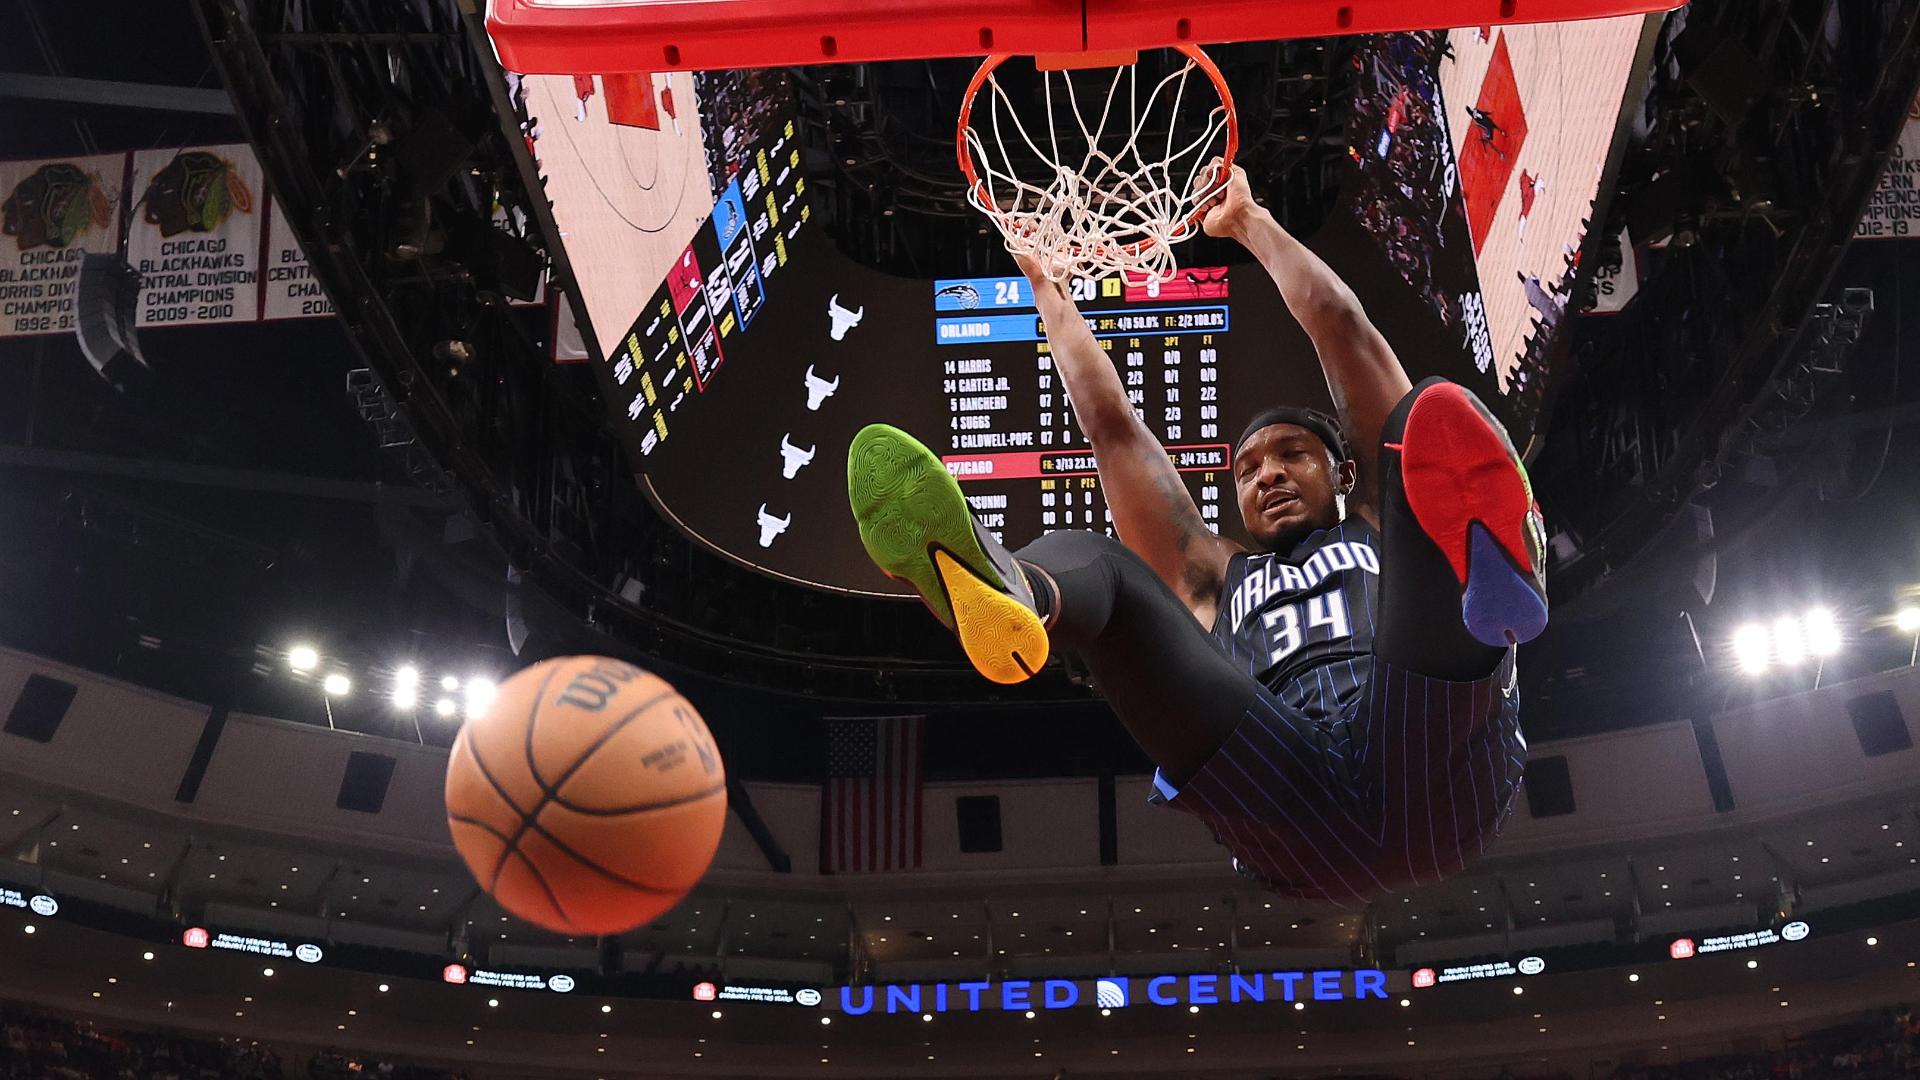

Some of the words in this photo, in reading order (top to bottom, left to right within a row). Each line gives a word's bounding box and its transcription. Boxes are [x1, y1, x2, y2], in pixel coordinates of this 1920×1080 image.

[161, 238, 227, 256] CHICAGO
[139, 253, 245, 274] BLACKHAWKS
[197, 269, 258, 286] DIVISION
[146, 287, 235, 306] CHAMPIONS
[995, 281, 1020, 305] 24
[145, 304, 234, 323] 2009-2010
[1164, 315, 1177, 327] FT:
[1177, 313, 1194, 328] 2/2
[941, 322, 991, 338] ORLANDO
[1164, 337, 1179, 347] 3PT
[1203, 335, 1213, 345] FT
[1127, 351, 1144, 366] 0/0
[1163, 350, 1181, 365] 0/0
[1200, 348, 1217, 363] 0/0
[944, 361, 956, 374] 14
[958, 359, 992, 374] HARRIS
[1039, 375, 1051, 389] 07
[1127, 370, 1144, 385] 2/3
[1164, 369, 1179, 384] 0/1
[1200, 367, 1217, 382] 0/0
[944, 379, 957, 393] 34
[958, 378, 994, 392] CARTER
[995, 377, 1011, 391] JR.
[1039, 394, 1052, 408] 07
[1166, 388, 1179, 402] 1/1
[1200, 386, 1217, 401] 2/2
[950, 398, 958, 412] 5
[959, 396, 1007, 411] BANCHERO
[1040, 412, 1052, 426] 07
[1064, 411, 1069, 425] 1
[1165, 406, 1181, 421] 2/3
[1201, 405, 1218, 420] 0/0
[951, 416, 958, 430] 4
[960, 415, 991, 430] SUGGS
[1040, 431, 1053, 445] 07
[1063, 430, 1070, 445] 0
[1167, 425, 1182, 440] 1/3
[1201, 423, 1218, 438] 0/0
[952, 435, 959, 449] 3
[961, 432, 1034, 448] CALDWELL-POPE
[1055, 458, 1074, 472] 3/13
[1180, 452, 1195, 466] 3/4
[1195, 451, 1221, 465] 75.0%
[946, 460, 993, 475] CHICAGO
[1041, 479, 1056, 490] MIN
[1065, 479, 1071, 489] F
[1080, 478, 1096, 489] PTS
[1205, 472, 1214, 482] FT
[1064, 491, 1072, 506] 0
[1084, 491, 1092, 505] 0
[1202, 486, 1218, 501] 0/0
[1065, 510, 1073, 524] 0
[1085, 509, 1093, 523] 0
[1202, 504, 1218, 519] 0/0
[1231, 541, 1380, 635] ORLANDO
[1262, 588, 1351, 665] 34
[841, 980, 1080, 1015] UNITED
[1147, 969, 1389, 1005] CENTER
